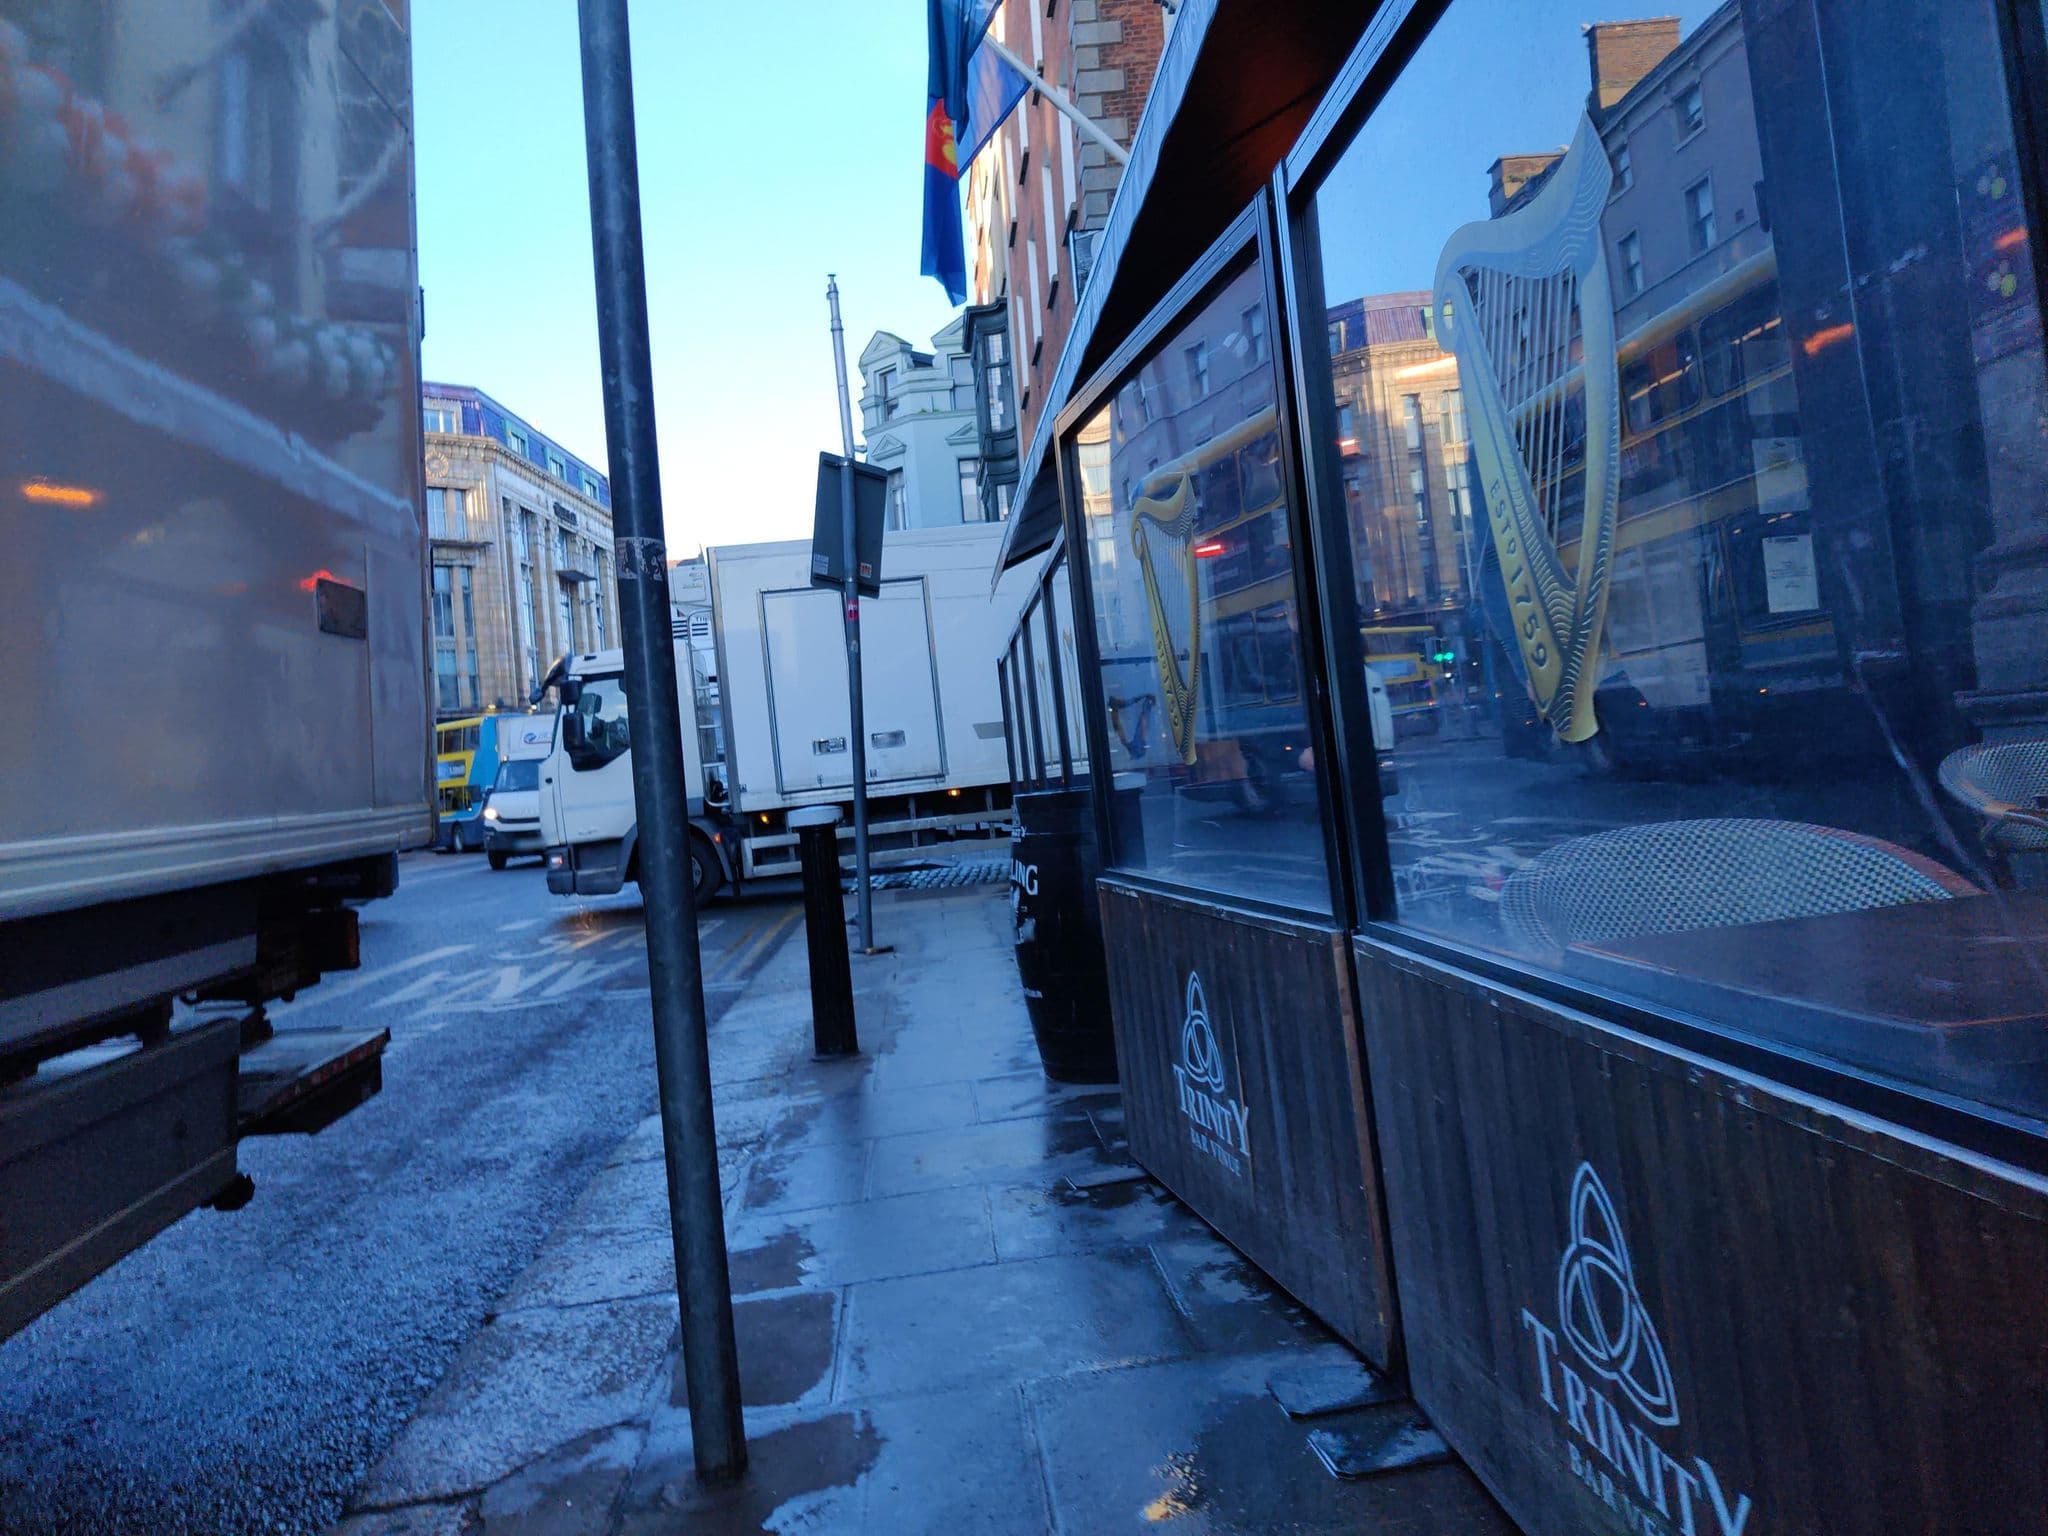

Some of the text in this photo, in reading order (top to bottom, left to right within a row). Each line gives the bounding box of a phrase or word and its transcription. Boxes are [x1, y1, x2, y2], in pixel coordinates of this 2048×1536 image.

[1510, 566, 1550, 669] 1759
[1173, 1063, 1250, 1157] TRINITY
[1521, 1307, 1752, 1536] TRINITY
